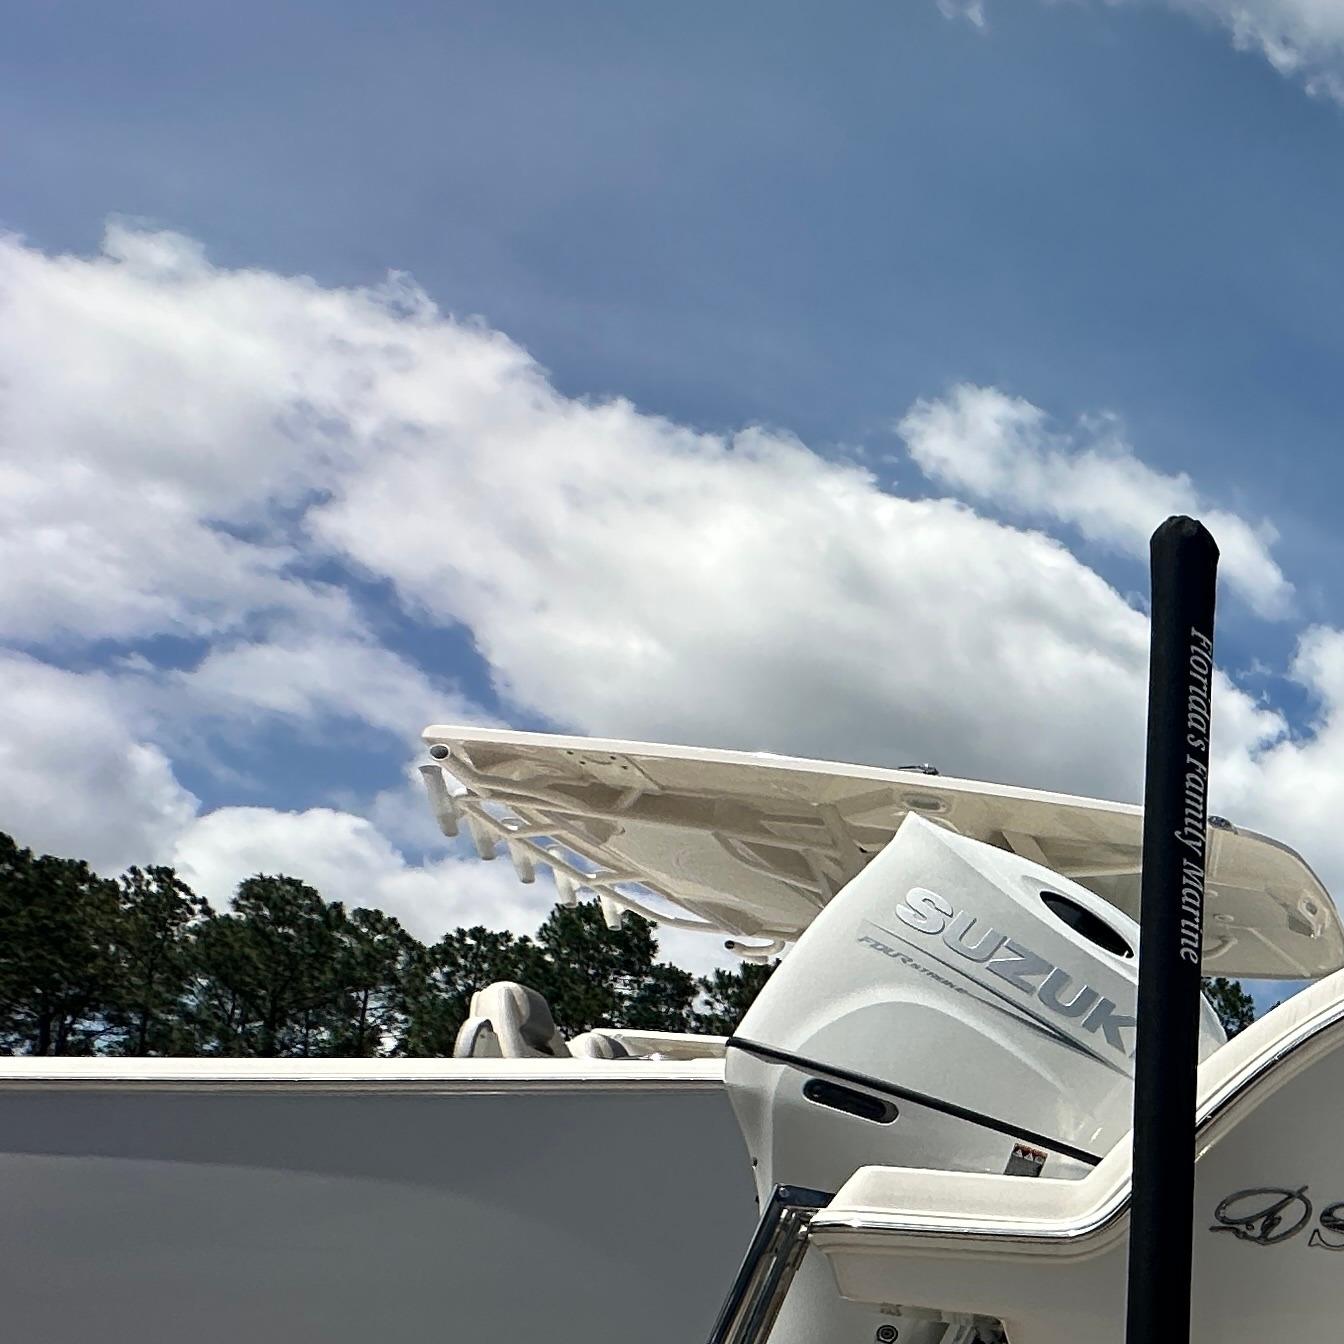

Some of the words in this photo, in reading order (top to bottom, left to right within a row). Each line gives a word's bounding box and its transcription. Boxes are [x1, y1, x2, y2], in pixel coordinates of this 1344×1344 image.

[1187, 626, 1213, 751] Florida's
[1174, 754, 1208, 856] Family
[1180, 858, 1205, 964] Marine
[895, 887, 1137, 1057] SUZUK
